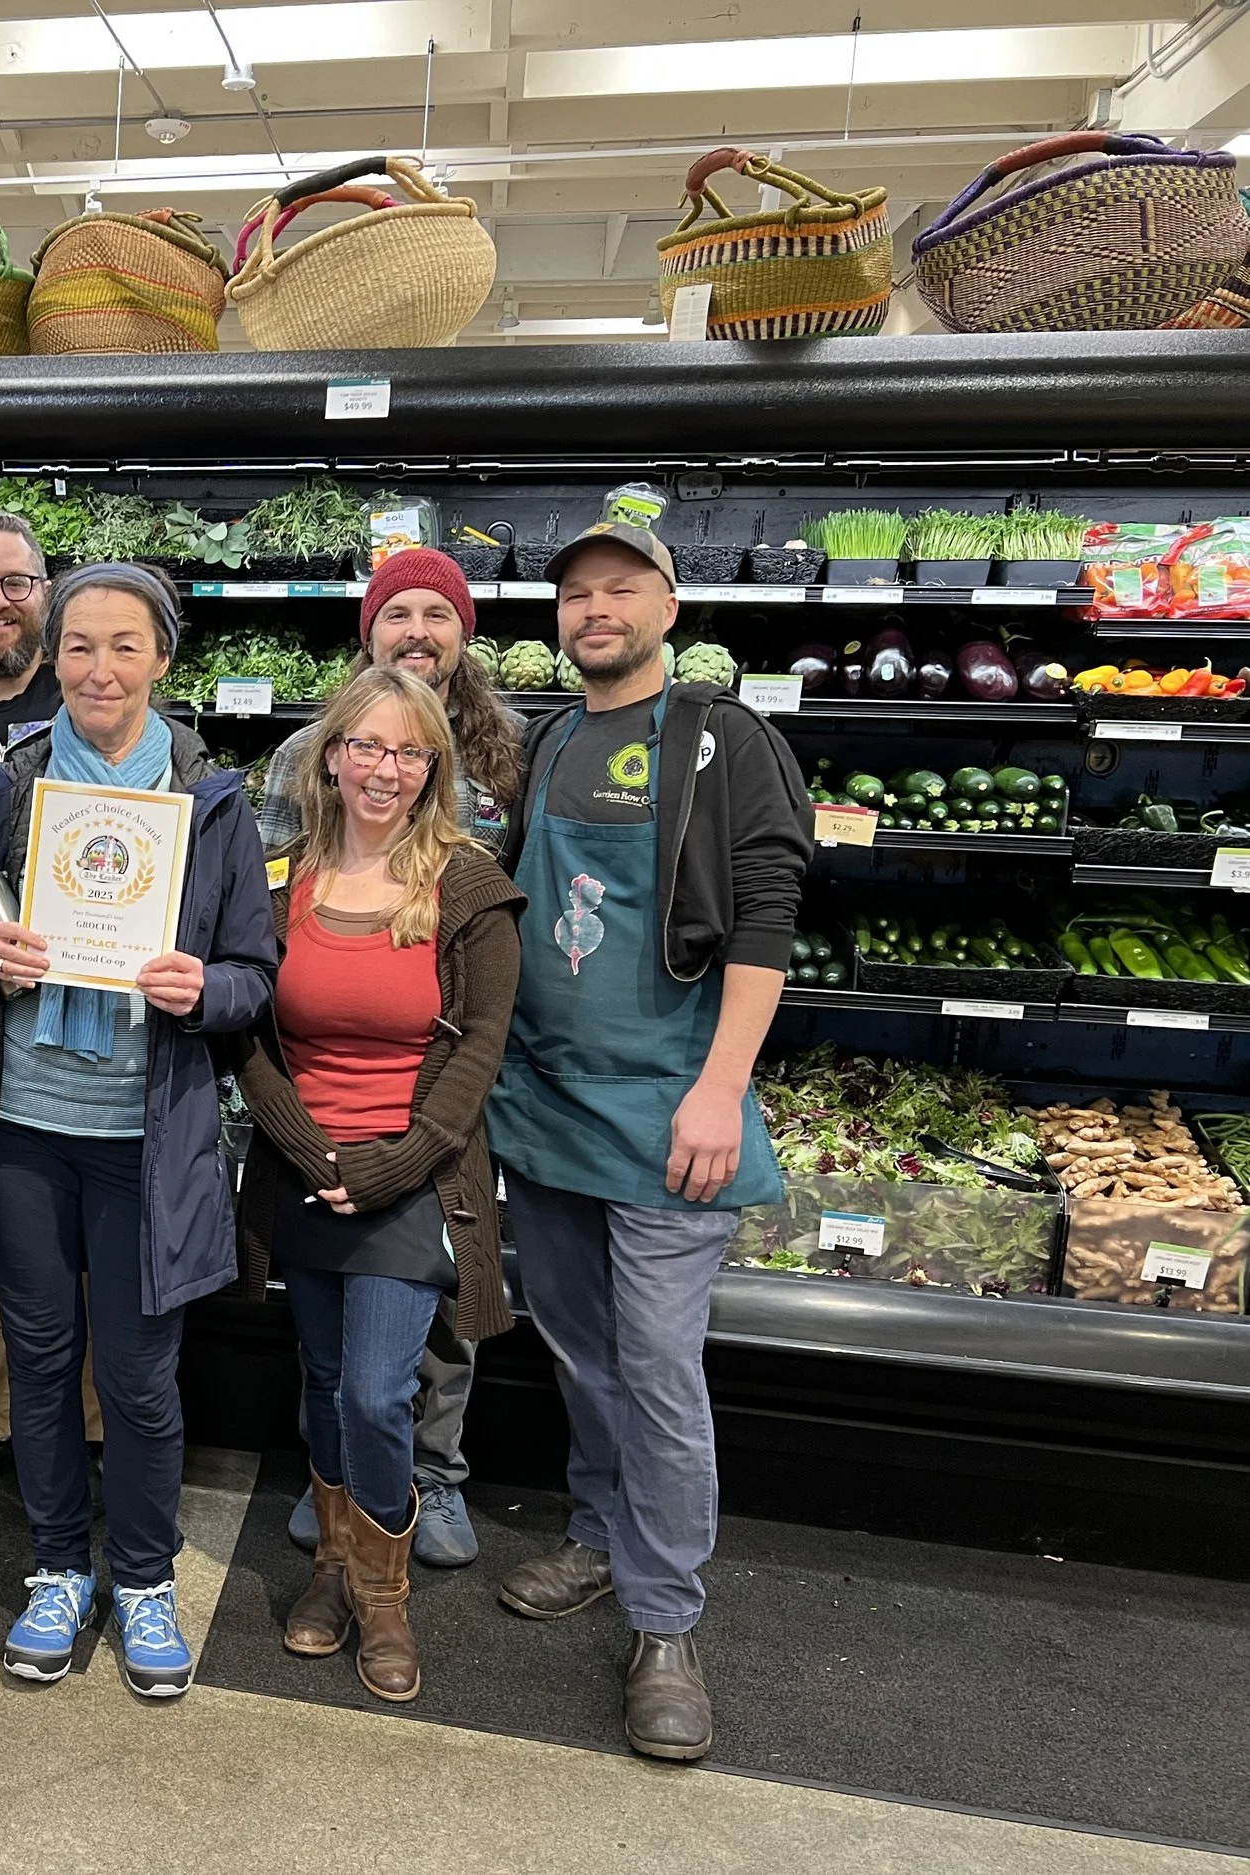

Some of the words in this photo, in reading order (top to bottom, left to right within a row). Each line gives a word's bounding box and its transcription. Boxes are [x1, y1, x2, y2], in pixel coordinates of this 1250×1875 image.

[620, 790, 641, 802] Row
[51, 804, 92, 835] Readers'
[94, 803, 132, 818] Choice
[132, 813, 164, 847] Awards
[87, 889, 114, 901] 2025
[75, 919, 120, 933] GROCERY
[85, 937, 119, 949] PLACE
[60, 950, 76, 960] The
[77, 953, 99, 963] Food
[100, 955, 127, 969] Co-op
[836, 1235, 864, 1246] $12.99
[1159, 1265, 1187, 1277] $13.99
